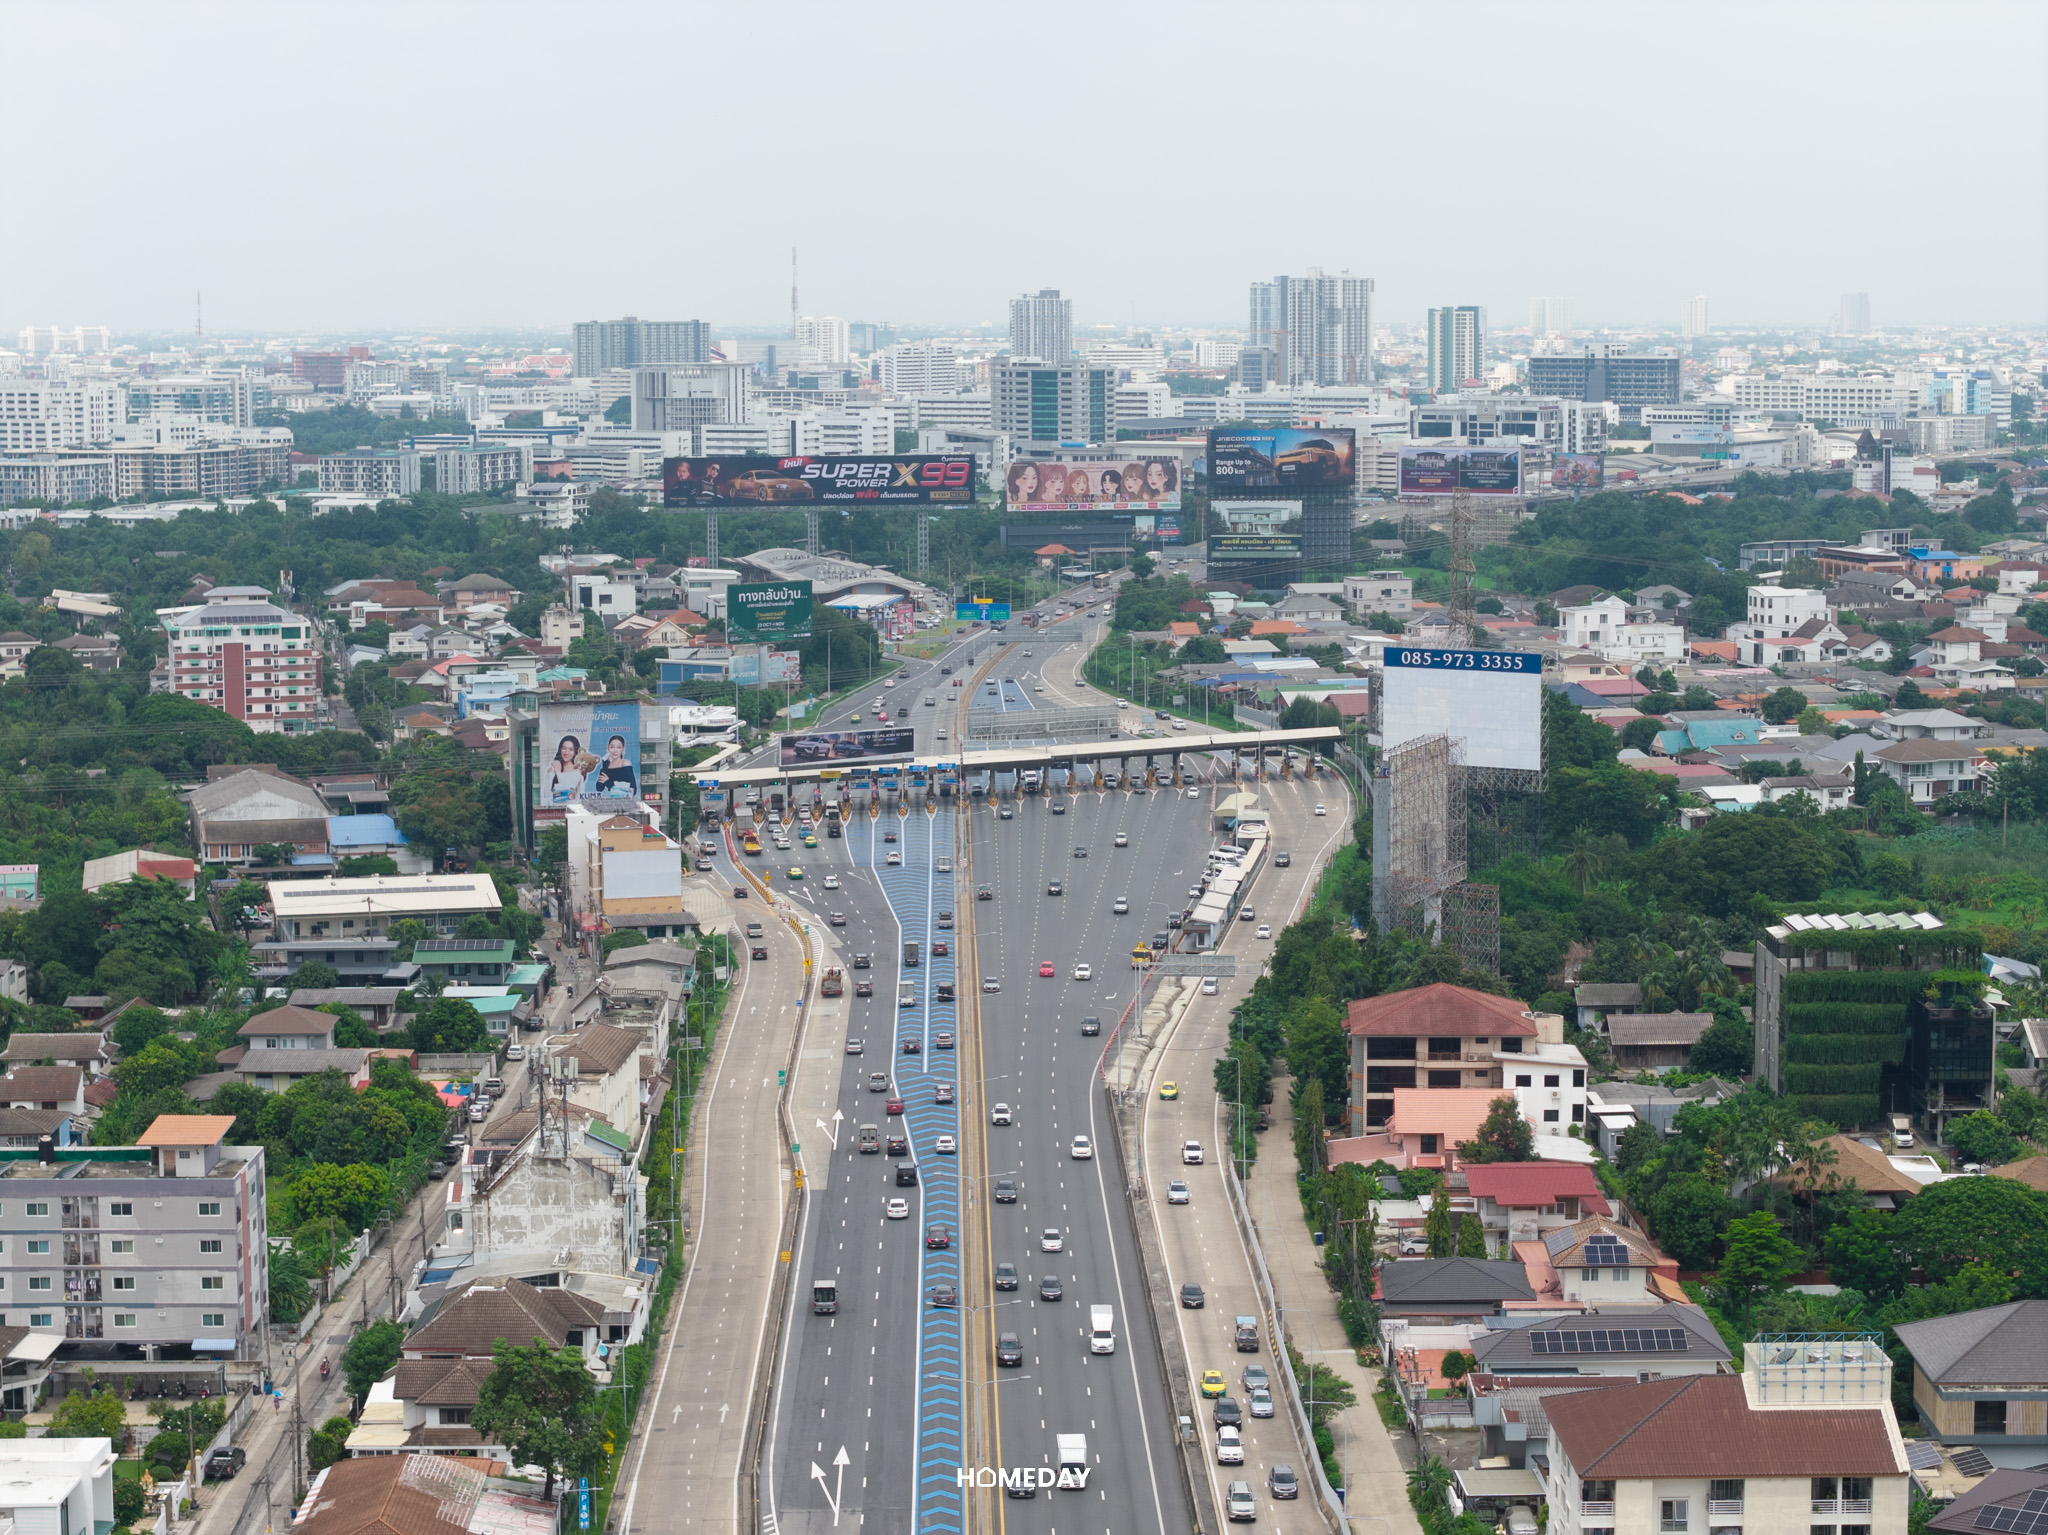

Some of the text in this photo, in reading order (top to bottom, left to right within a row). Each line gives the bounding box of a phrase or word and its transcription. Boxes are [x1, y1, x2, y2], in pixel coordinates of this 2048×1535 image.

[1216, 459, 1234, 467] Range
[800, 463, 892, 479] SUPER
[1216, 466, 1234, 475] 800
[835, 478, 888, 488] POWER
[823, 491, 854, 499] ปลดปล่อย
[856, 489, 879, 499] พลัง
[1401, 651, 1523, 670] 085-973 3355
